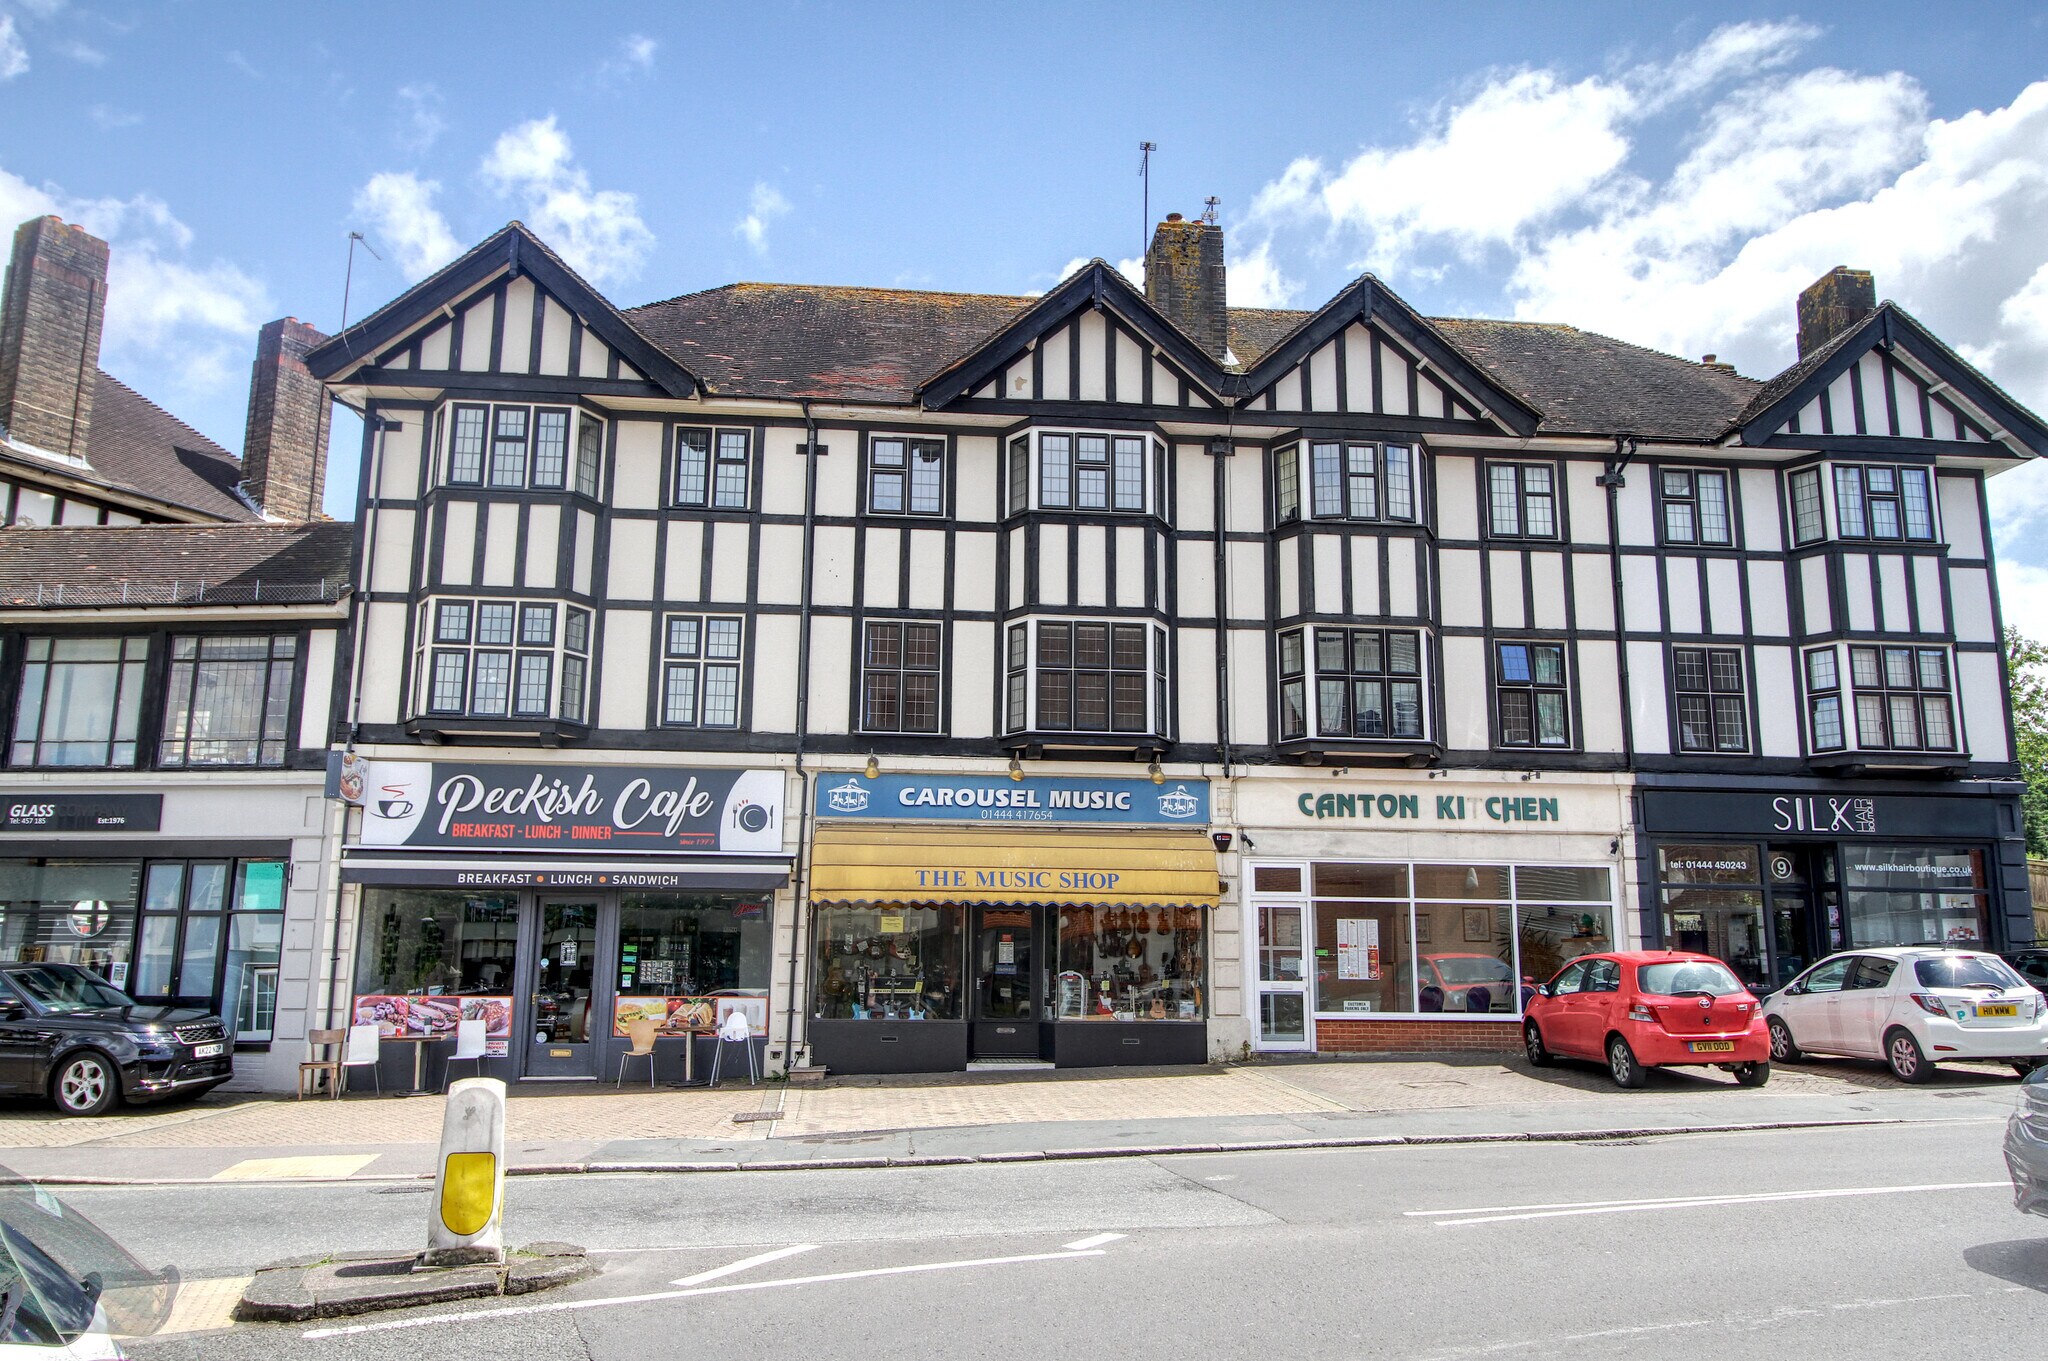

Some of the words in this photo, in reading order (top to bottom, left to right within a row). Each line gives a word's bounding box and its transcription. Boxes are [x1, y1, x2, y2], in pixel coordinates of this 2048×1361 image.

[437, 773, 604, 835] Peckish
[612, 776, 714, 838] Cafe
[898, 787, 1041, 808] CAROUSEL
[1048, 790, 1132, 810] MUSIC
[10, 804, 56, 817] GLASS
[1297, 792, 1419, 820] CANTON
[10, 817, 21, 825] Tel:
[21, 817, 34, 825] 457
[34, 817, 46, 825] 185
[981, 809, 1013, 820] 01444
[1015, 809, 1053, 821] 417654
[1772, 796, 1855, 832] SILK
[452, 823, 516, 838] BREAKFAST
[525, 825, 561, 839] LUNCH
[571, 826, 612, 840] DINNER
[1670, 860, 1684, 869] tel:
[1685, 861, 1713, 869] 01444
[1714, 861, 1747, 870] 450243
[1776, 861, 1787, 875] 9
[1854, 863, 1973, 875] www.silkhairboutique.co.uk
[457, 873, 532, 884] BREAKFAST
[550, 874, 593, 884] LUNCH
[612, 875, 679, 886] SANDWICH
[914, 870, 967, 887] THE
[975, 871, 1051, 888] MUSIC
[1059, 871, 1120, 889] SHOP
